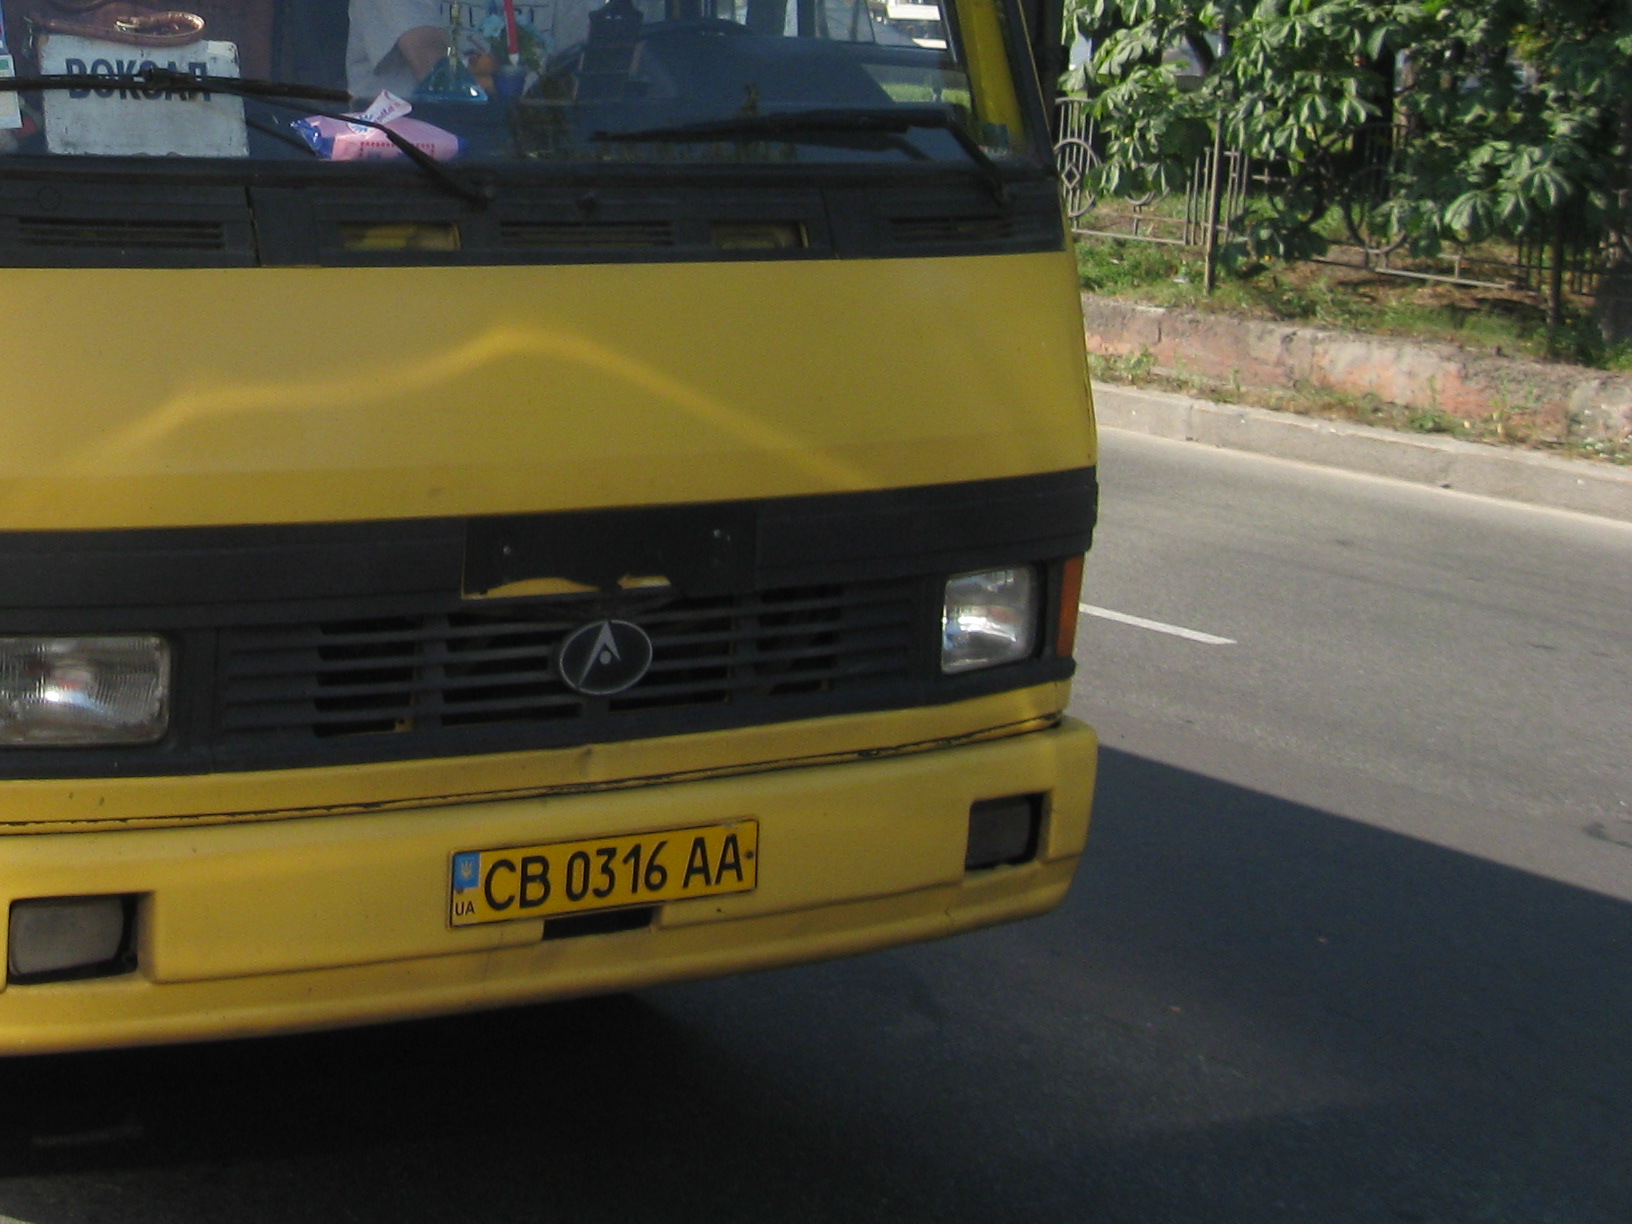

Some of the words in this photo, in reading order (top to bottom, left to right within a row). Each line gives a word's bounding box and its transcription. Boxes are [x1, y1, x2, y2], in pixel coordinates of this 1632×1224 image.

[484, 855, 552, 911] CB
[565, 841, 668, 902] 0316
[682, 833, 744, 889] AA
[455, 900, 475, 917] UA
